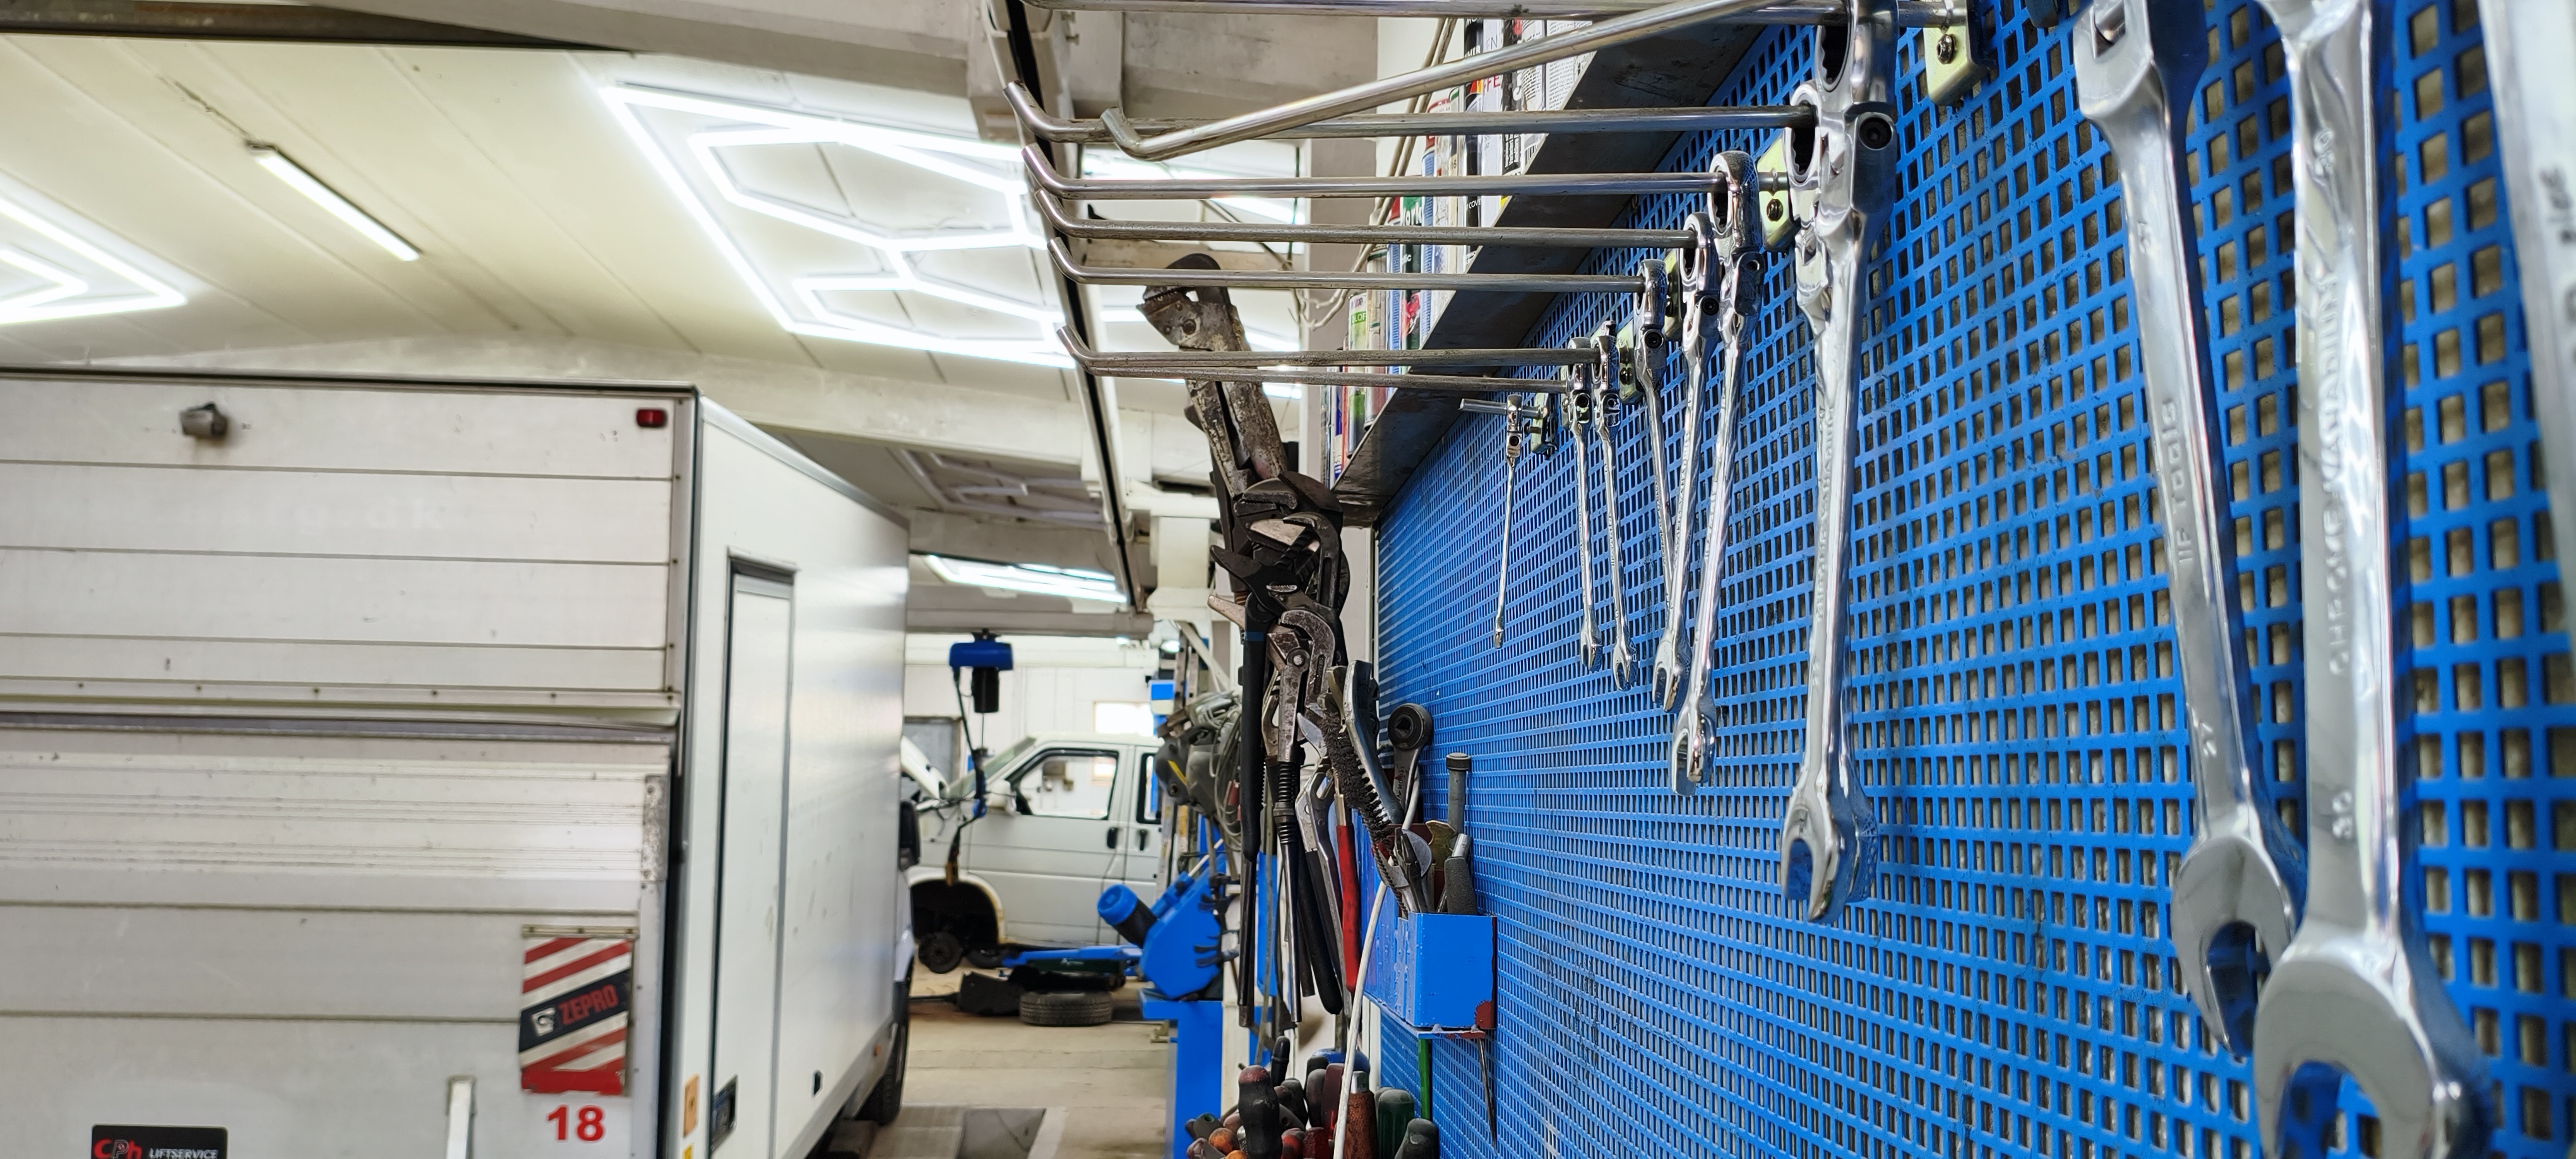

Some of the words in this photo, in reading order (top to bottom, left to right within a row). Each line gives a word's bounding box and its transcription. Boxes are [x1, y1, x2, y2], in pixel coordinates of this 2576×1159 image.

[558, 984, 619, 1025] ZEPRO
[547, 1104, 605, 1141] 18
[148, 1148, 219, 1159] LIFTSERVICE
